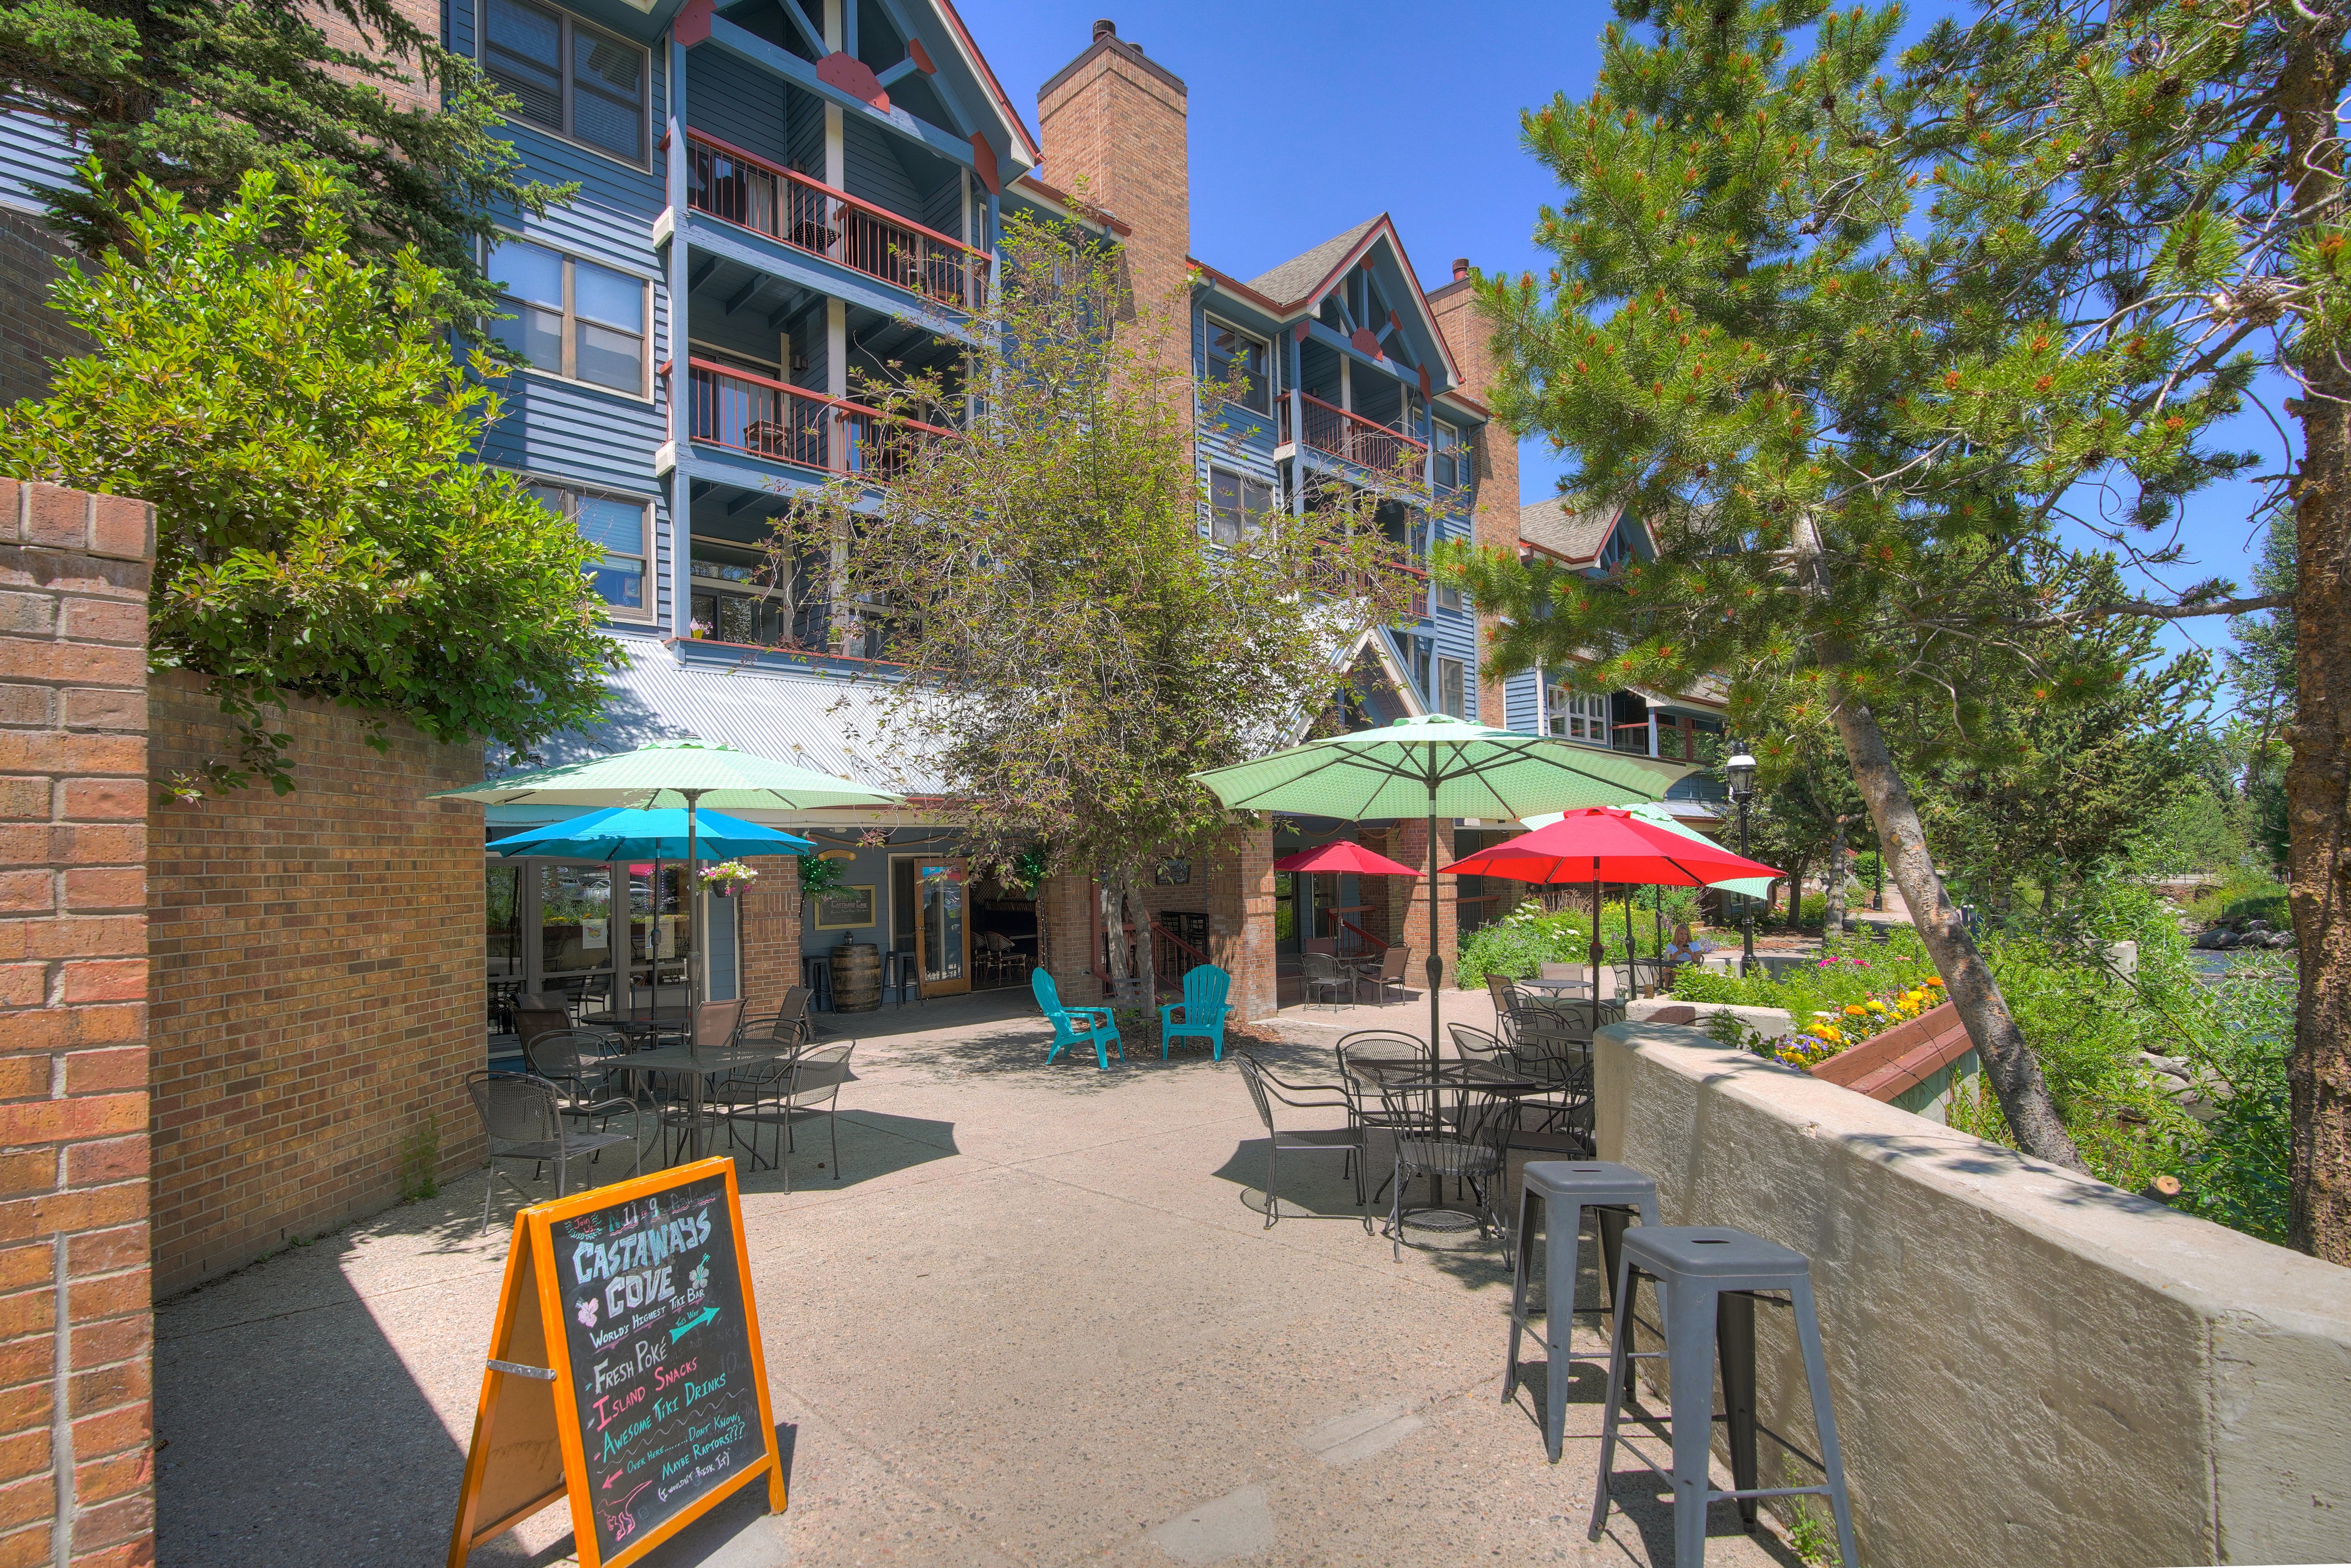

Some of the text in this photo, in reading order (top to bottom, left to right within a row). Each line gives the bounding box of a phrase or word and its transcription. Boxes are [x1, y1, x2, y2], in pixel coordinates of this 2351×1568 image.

[573, 1207, 711, 1285] CASTAWAYS
[574, 1217, 590, 1229] Join
[590, 1288, 705, 1349] WORLD'S HIGHEST TiKI BAR
[605, 1265, 675, 1319] COVE
[687, 1309, 699, 1320] WAY
[593, 1358, 634, 1395] FRESH
[636, 1336, 668, 1373] POKÉ
[593, 1357, 697, 1432] ISLAND SNACKS
[603, 1373, 727, 1464] AWESOME TiKI DRINKS
[627, 1457, 646, 1473] OVER
[689, 1423, 711, 1442] DONT
[714, 1411, 741, 1430] KNOW,
[662, 1421, 745, 1481] MAYBE RAPTORS???
[696, 1464, 715, 1477] RISK
